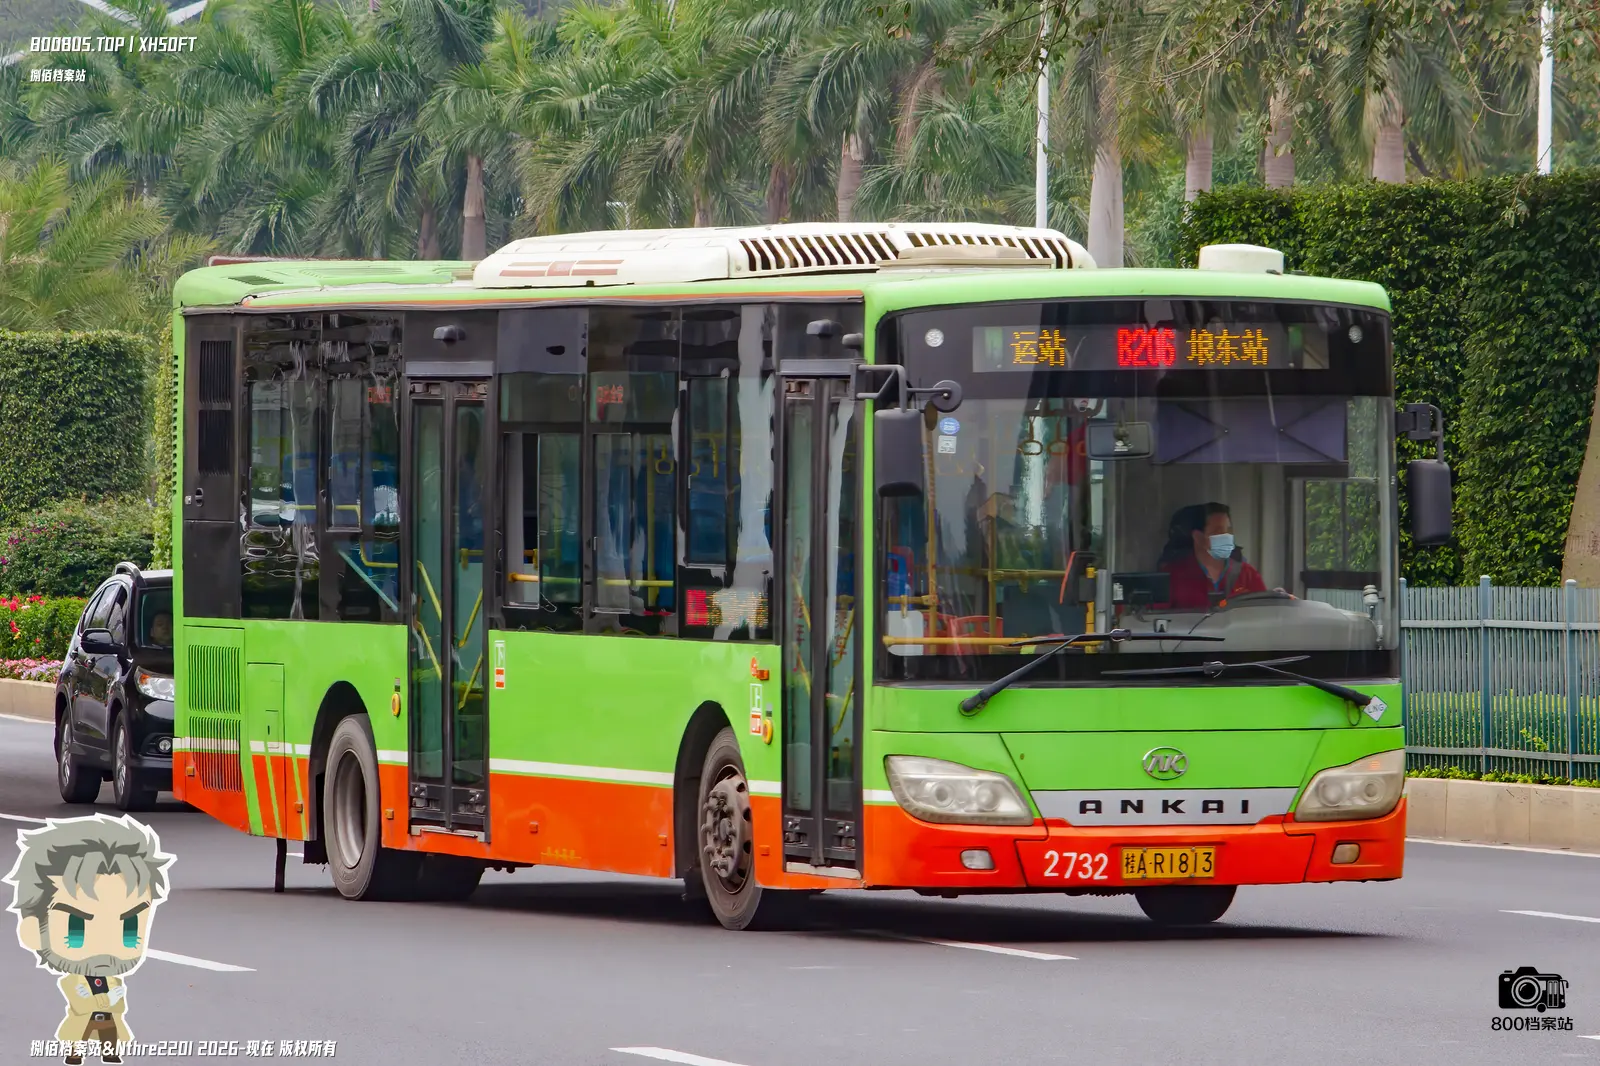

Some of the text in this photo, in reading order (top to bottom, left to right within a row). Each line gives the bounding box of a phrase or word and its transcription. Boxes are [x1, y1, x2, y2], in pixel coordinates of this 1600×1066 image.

[1010, 328, 1269, 366] 运站 B206 埌东站
[1079, 799, 1249, 814] ANKAI
[1043, 850, 1109, 880] 2732
